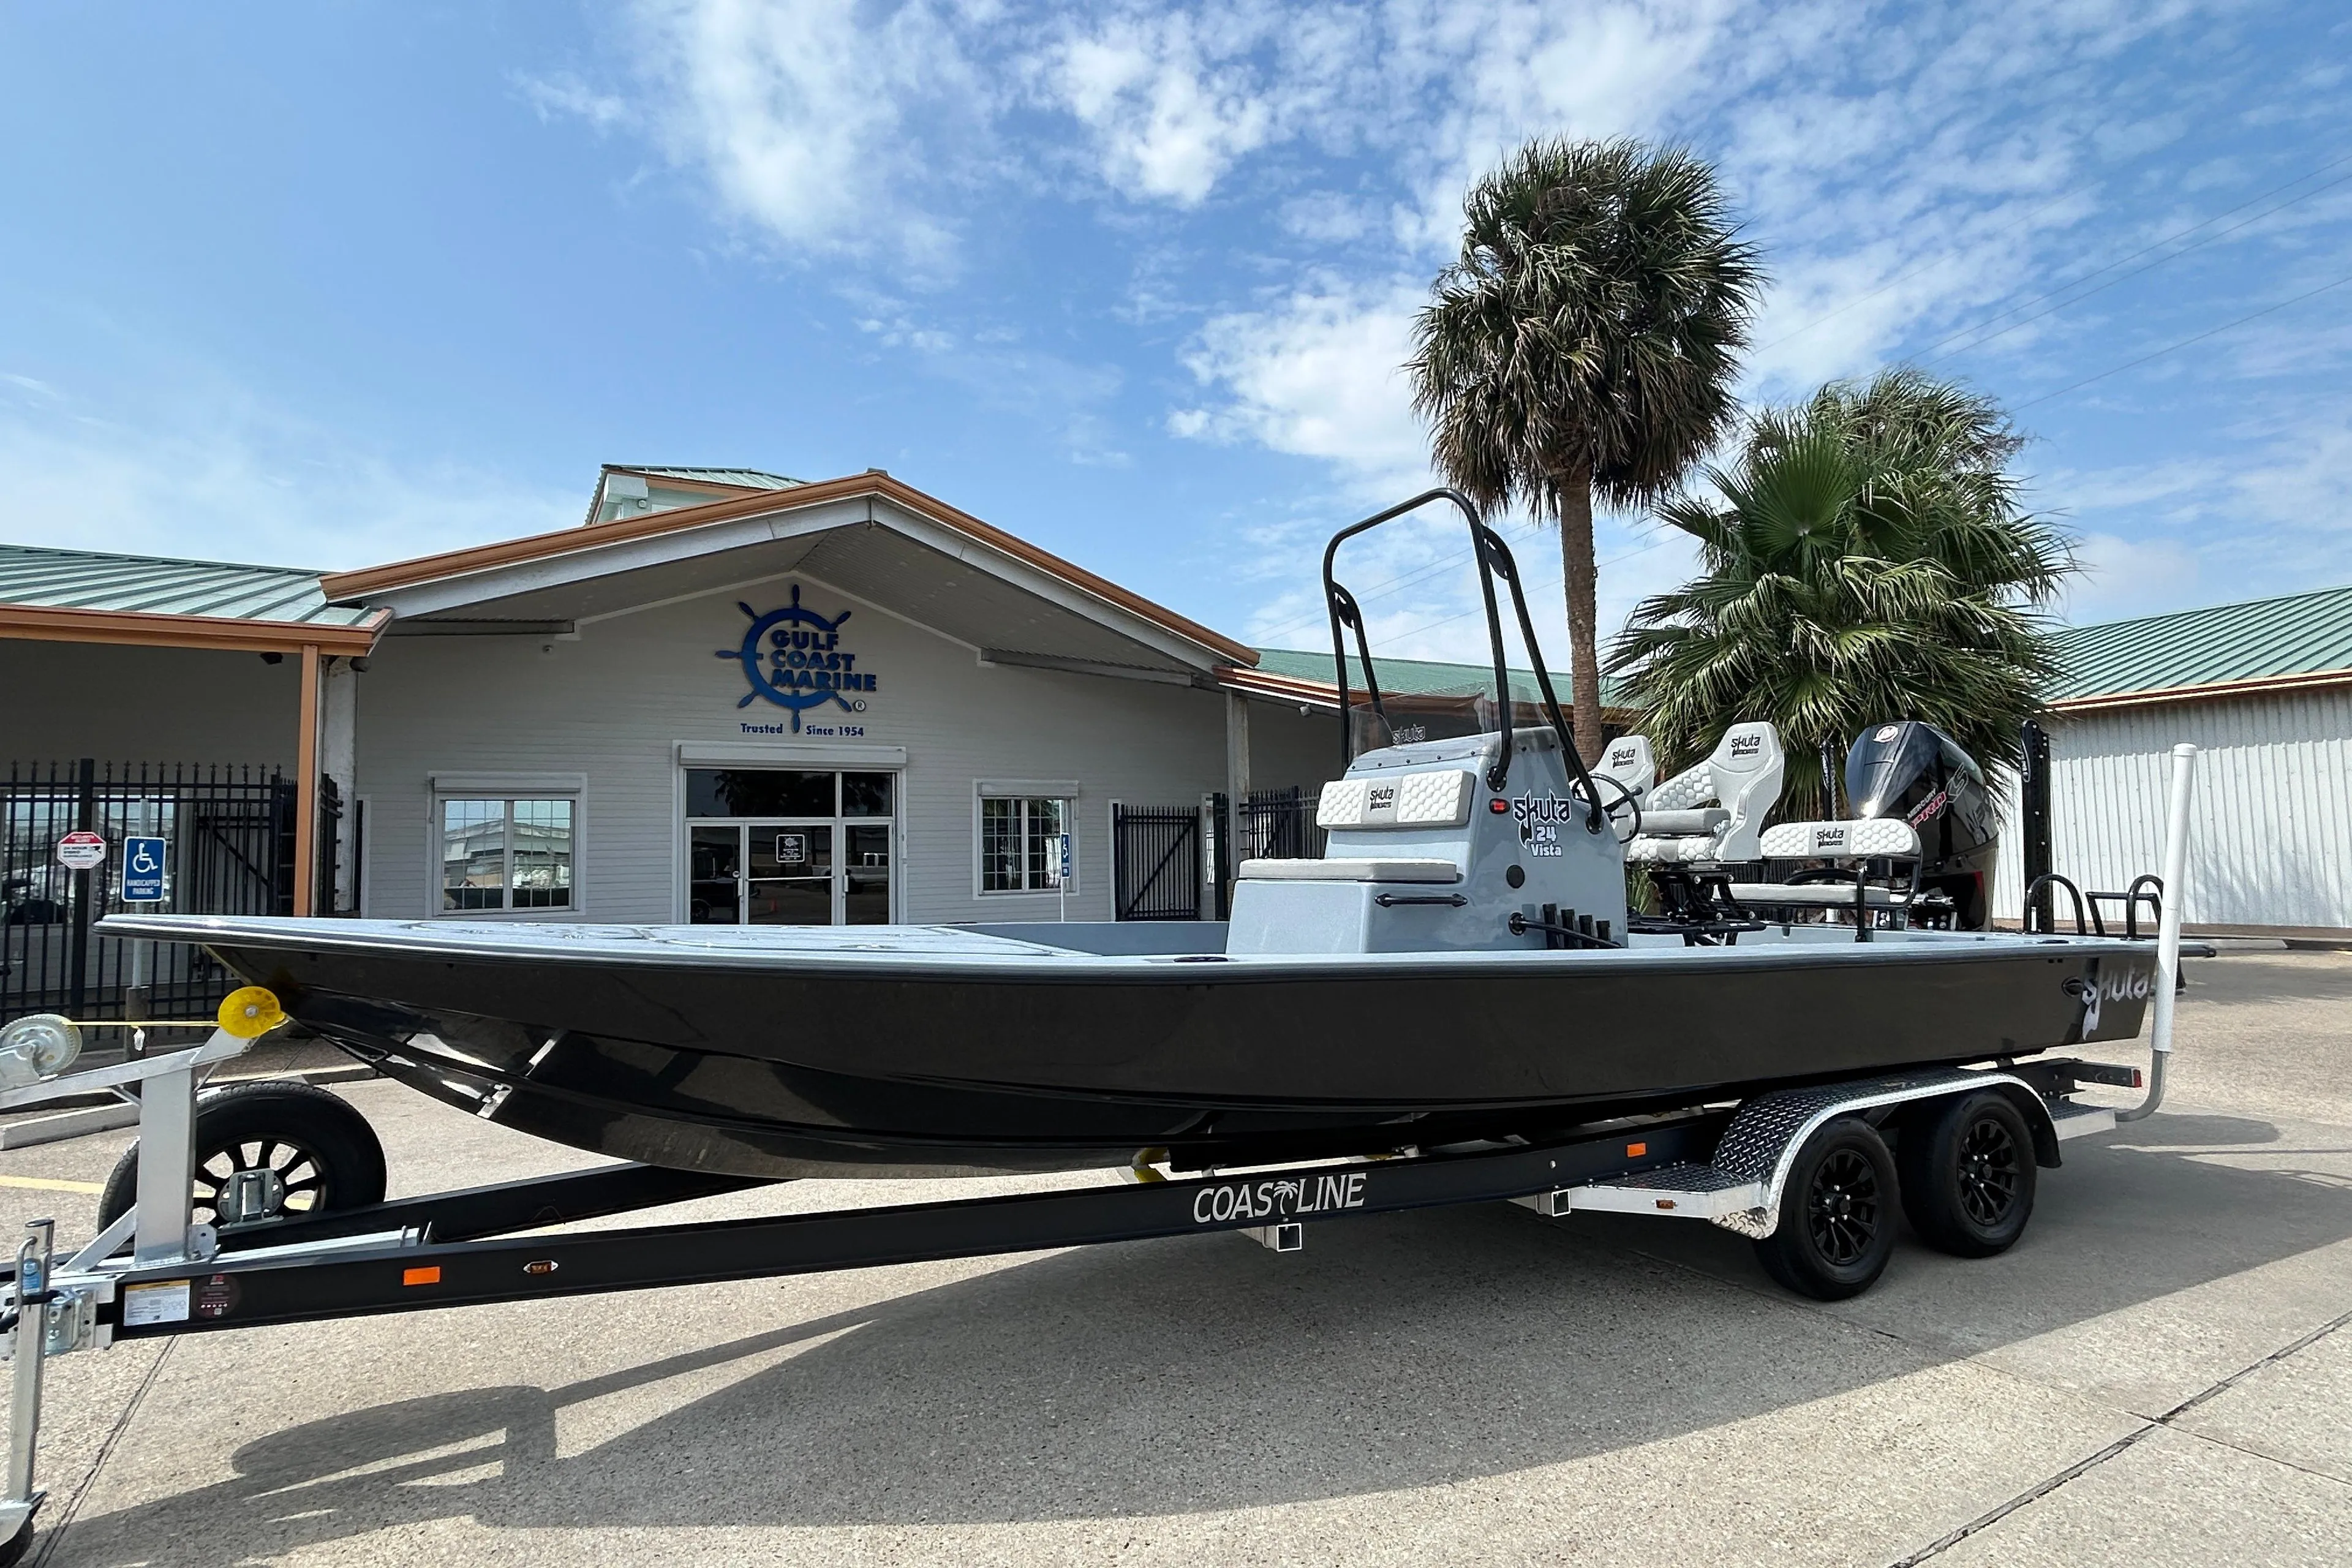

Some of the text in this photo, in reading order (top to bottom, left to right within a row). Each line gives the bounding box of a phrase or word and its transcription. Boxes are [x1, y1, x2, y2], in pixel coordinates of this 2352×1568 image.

[771, 630, 839, 651] GULF
[771, 649, 856, 672] COAST
[771, 669, 877, 692] MARINE
[740, 723, 864, 737] Trusted Since 1954
[1907, 787, 1937, 820] MERCURY
[1910, 791, 1947, 831] PRO
[1536, 825, 1557, 842] 24
[1530, 843, 1562, 857] Vista
